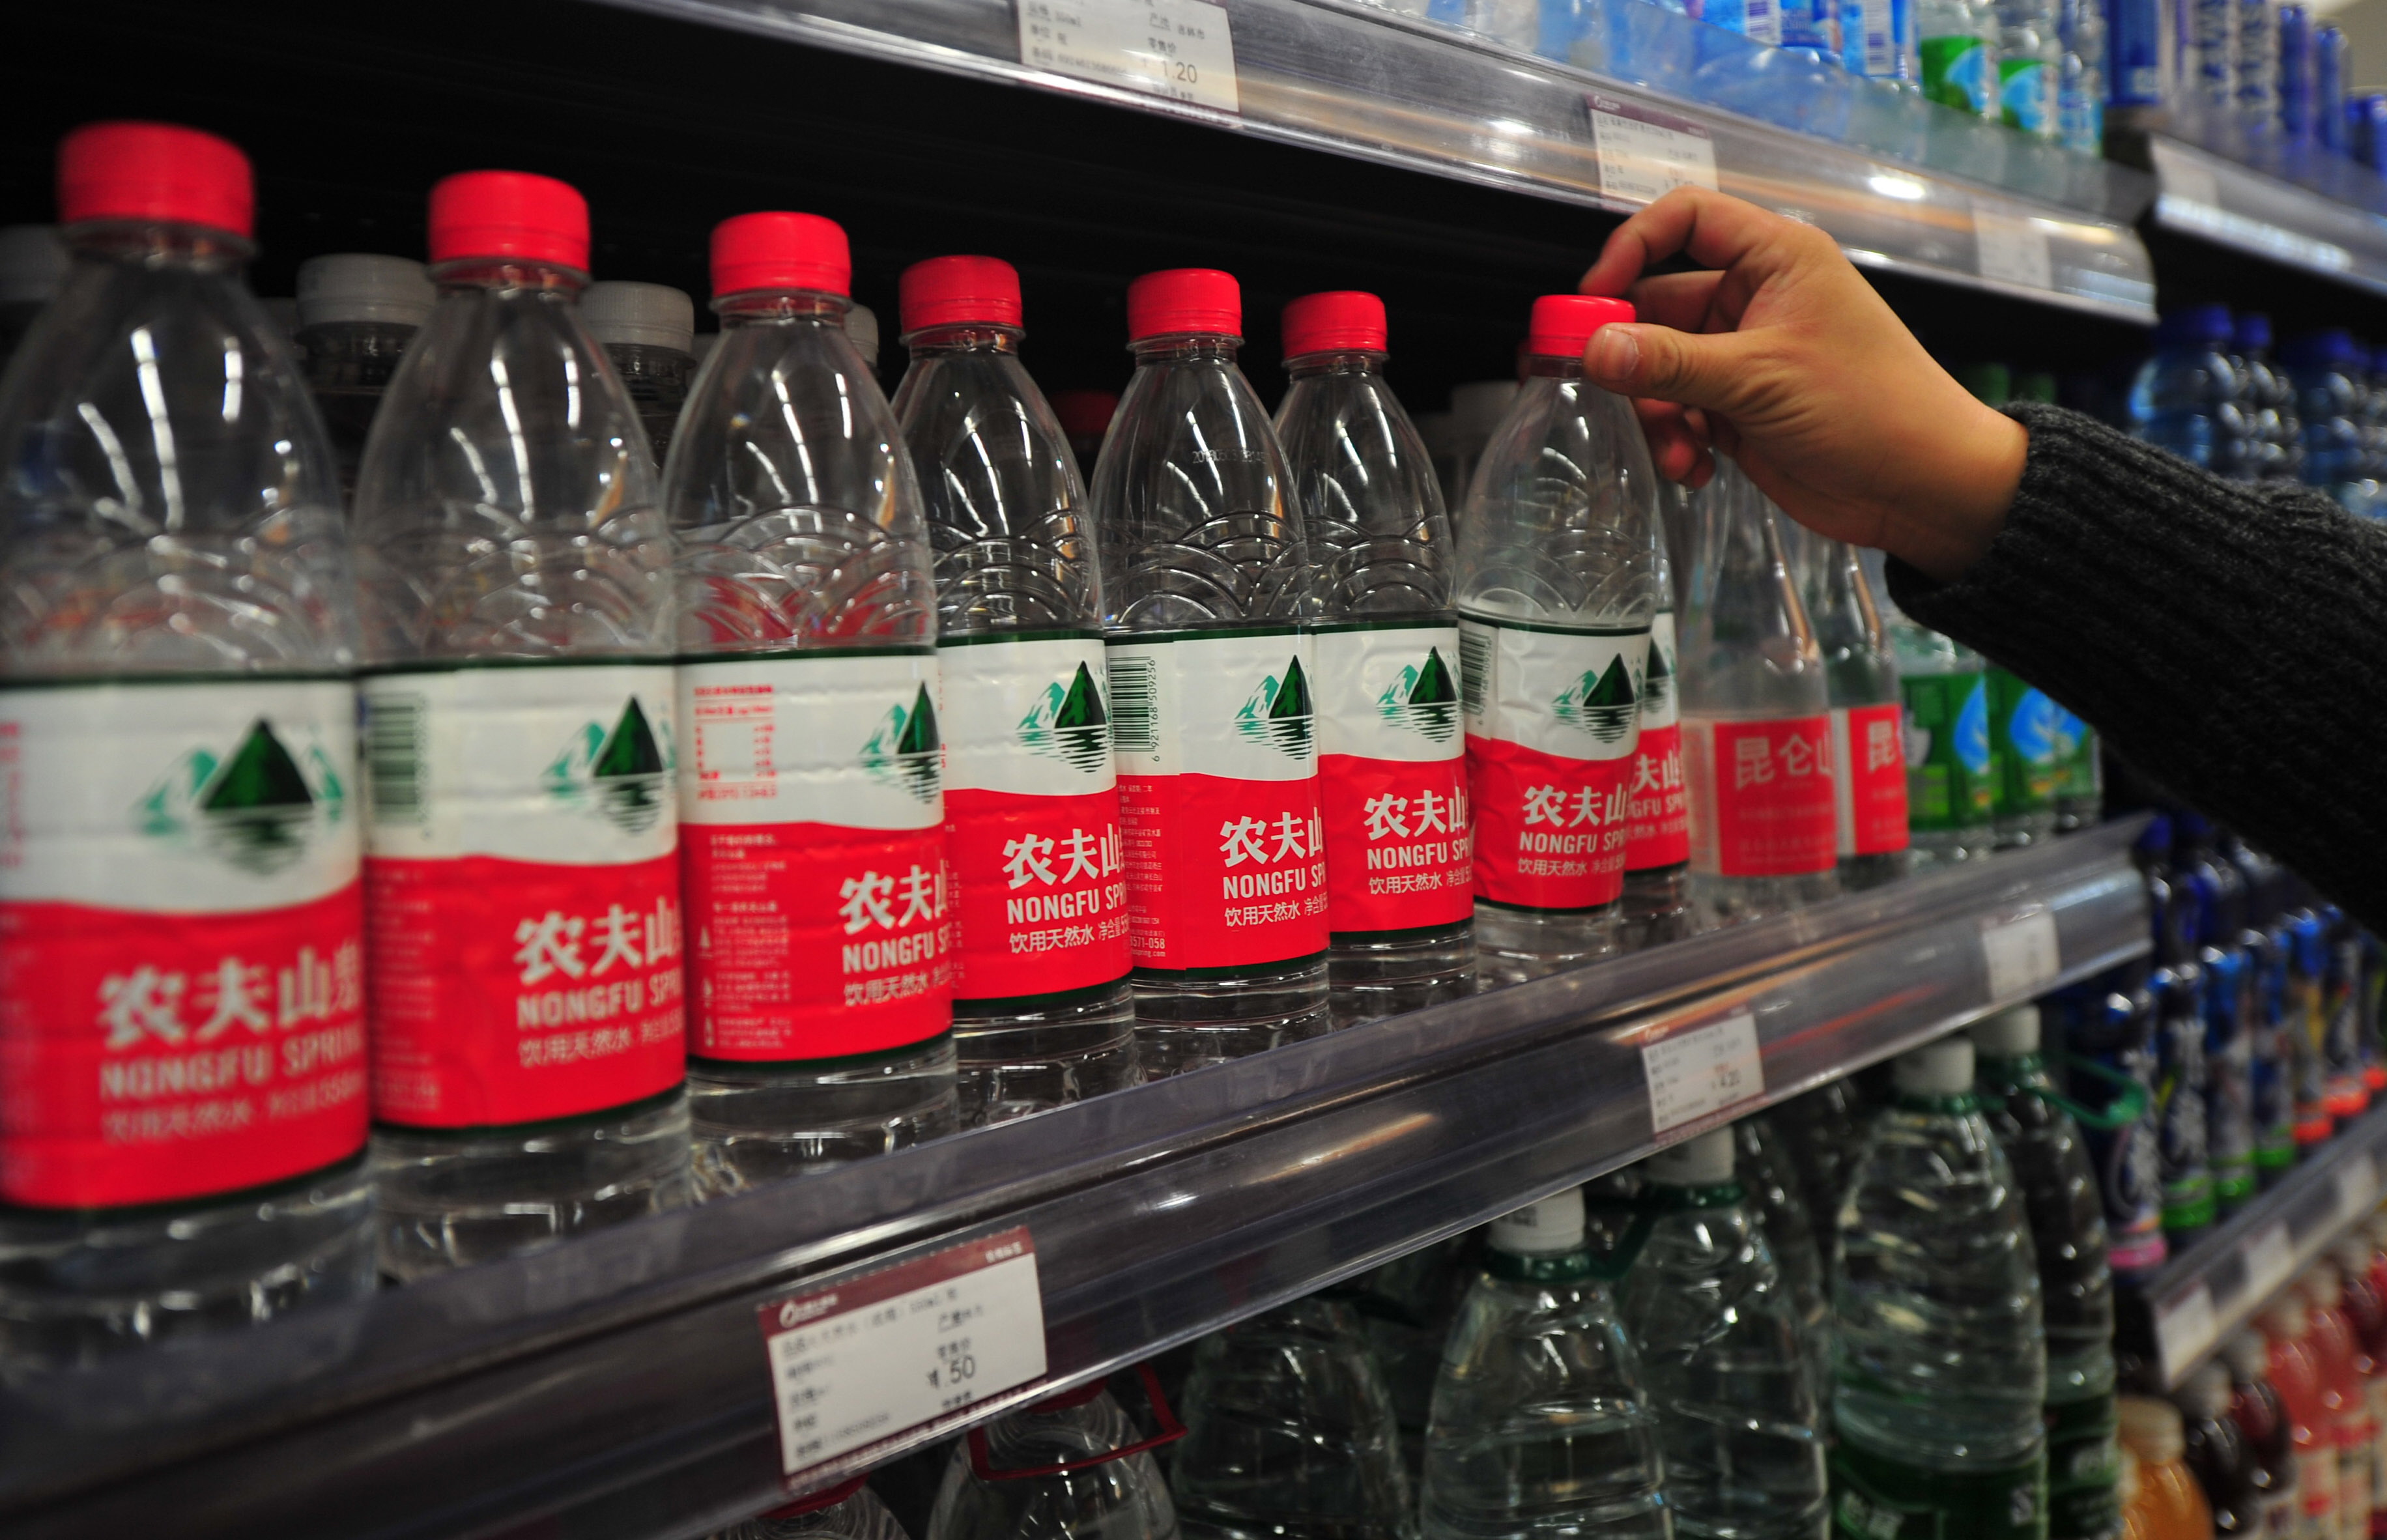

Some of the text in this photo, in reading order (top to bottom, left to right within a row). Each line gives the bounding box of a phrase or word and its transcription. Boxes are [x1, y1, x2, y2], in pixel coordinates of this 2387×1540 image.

[1147, 659, 1157, 701] 509256
[1150, 706, 1160, 748] 921168
[1629, 749, 1684, 793] 夫山
[1364, 786, 1468, 842] 农夫山
[1522, 783, 1627, 827] 农夫山
[1002, 823, 1124, 891] 农夫山
[1220, 806, 1324, 868] 农夫山
[1367, 841, 1448, 870] NONGFU
[1519, 831, 1597, 855] NONGFU
[1223, 867, 1306, 900] NONGFU
[1369, 872, 1443, 896] 饮用天然水
[1518, 857, 1588, 877] 饮用天然水
[1007, 887, 1100, 925] NONGFU
[1224, 900, 1301, 928] 饮用天然水
[842, 930, 934, 975] NONGFU
[1009, 924, 1095, 954] 饮用天然水
[517, 979, 645, 1030] NONGFU
[844, 972, 930, 1008] 饮用天然水
[100, 1019, 362, 1102] NONGFU SPRIN
